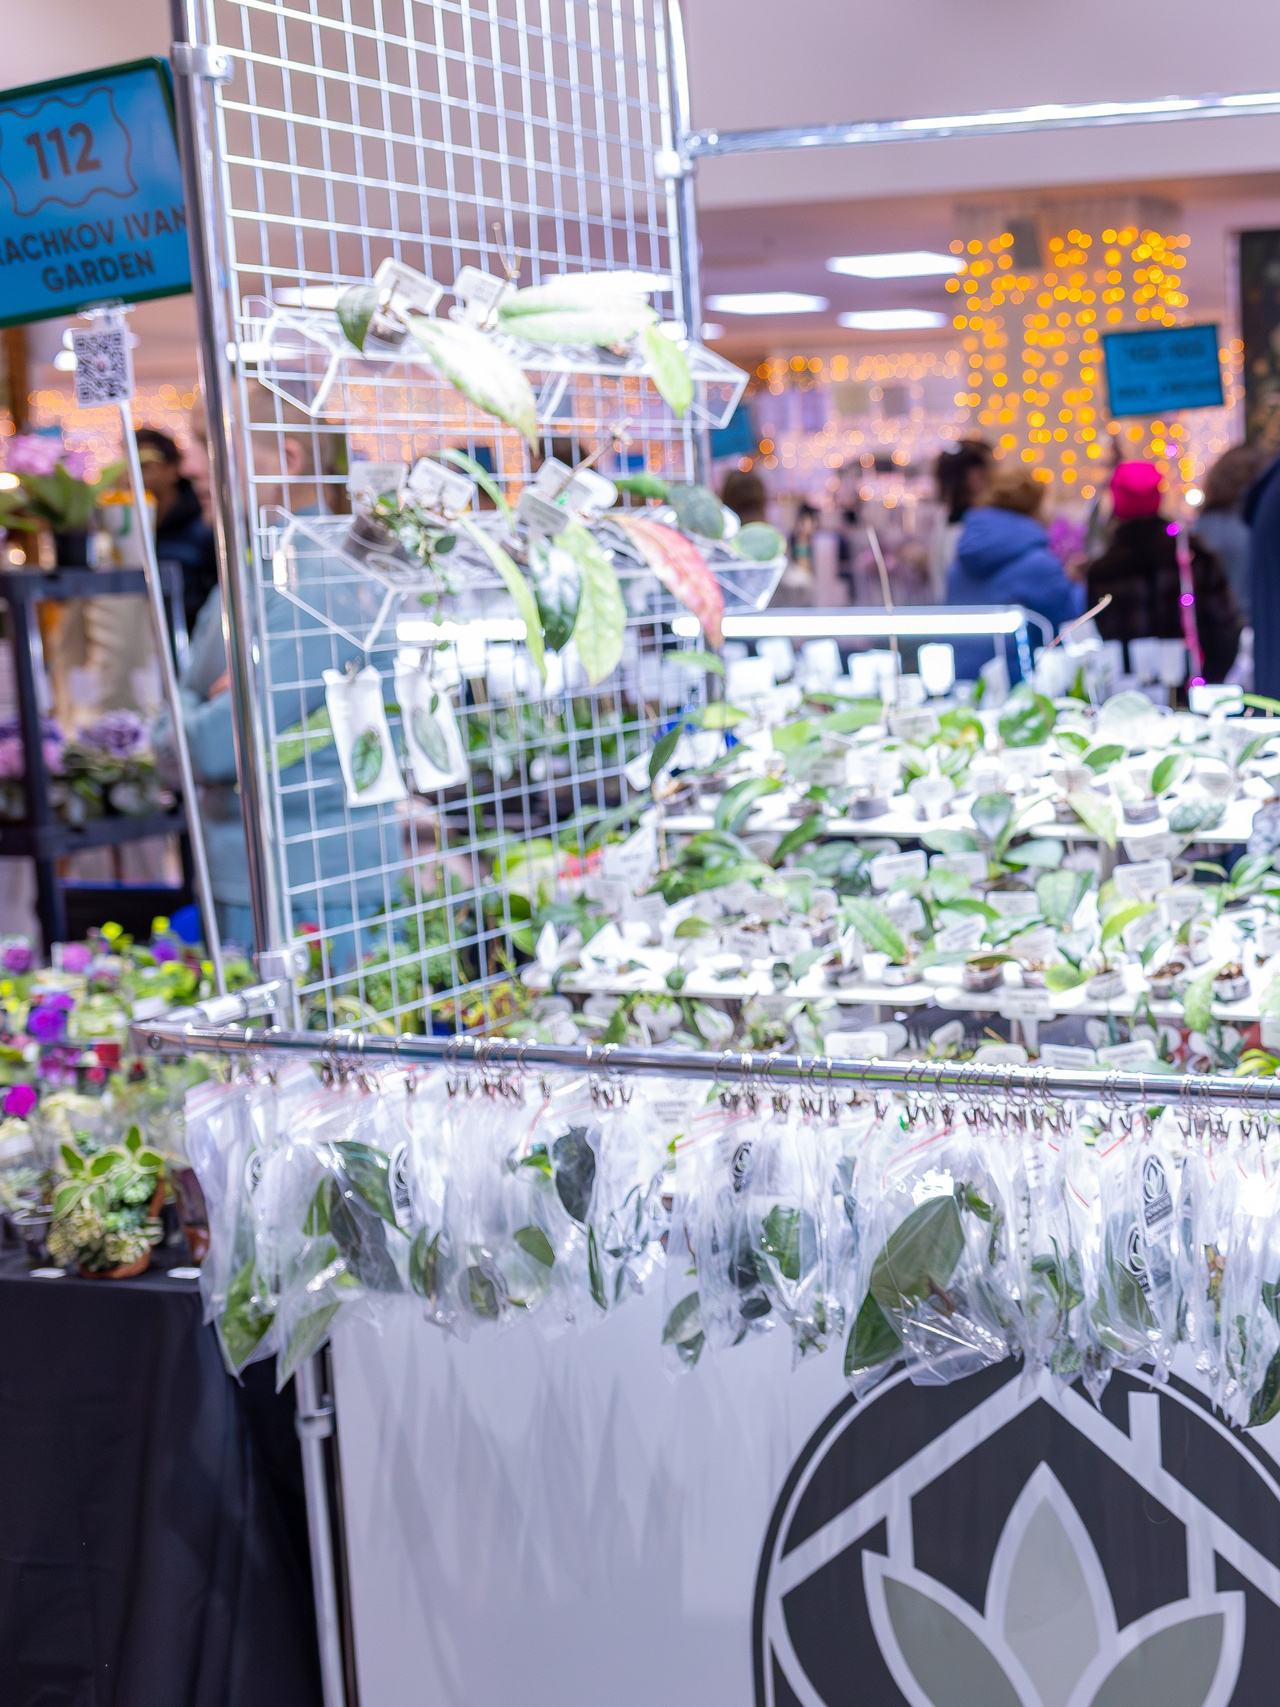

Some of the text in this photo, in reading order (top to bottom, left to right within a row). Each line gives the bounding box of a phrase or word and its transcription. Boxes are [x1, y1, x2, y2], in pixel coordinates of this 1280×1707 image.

[25, 121, 102, 181] 112
[0, 204, 186, 266] ACHKOV IVAN
[42, 249, 156, 292] GARDEN
